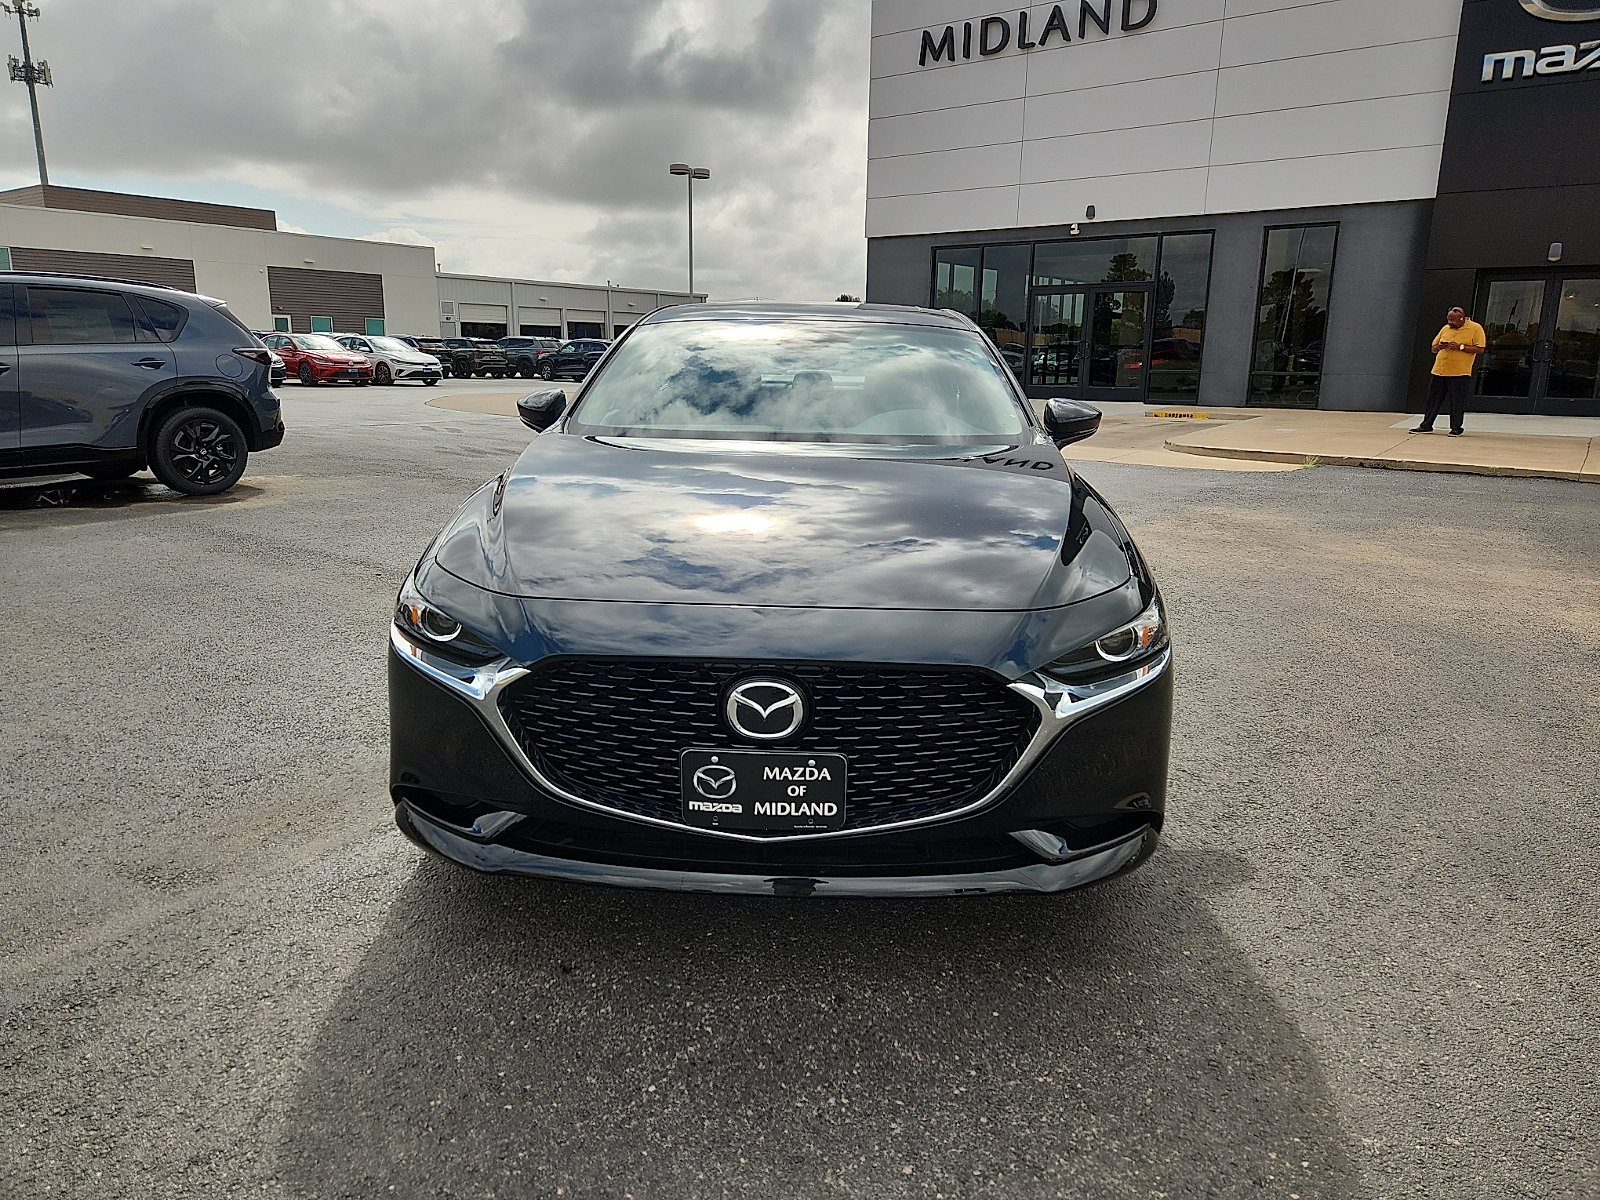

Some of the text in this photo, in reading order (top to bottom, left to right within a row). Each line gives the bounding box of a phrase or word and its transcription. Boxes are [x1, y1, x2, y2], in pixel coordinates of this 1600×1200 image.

[918, 0, 1159, 67] MIDLAND
[763, 766, 832, 781] MAZDA
[787, 785, 807, 797] OF
[688, 800, 743, 814] mazda
[753, 802, 838, 817] MIDLAND
